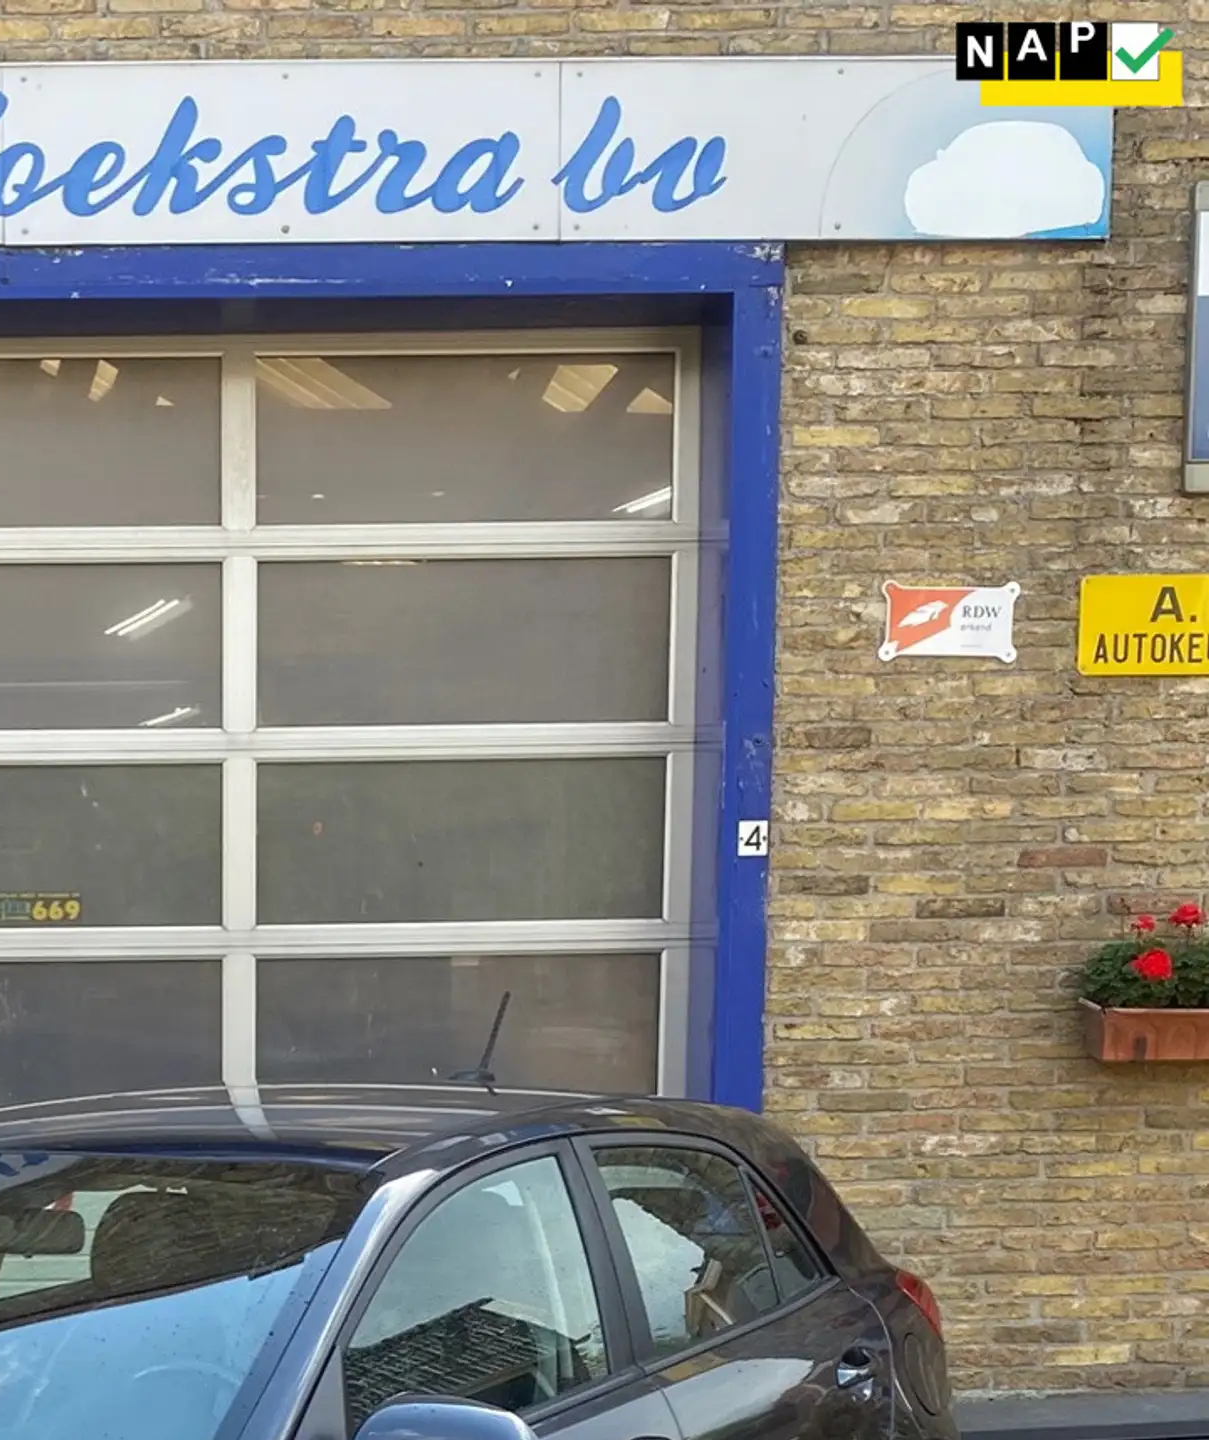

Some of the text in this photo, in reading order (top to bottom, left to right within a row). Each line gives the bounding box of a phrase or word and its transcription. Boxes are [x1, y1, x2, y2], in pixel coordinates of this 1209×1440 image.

[551, 96, 728, 213] bv
[962, 605, 1002, 618] RDW
[1093, 633, 1209, 664] AUTOKE
[744, 825, 762, 851] 4
[31, 899, 81, 921] 669
